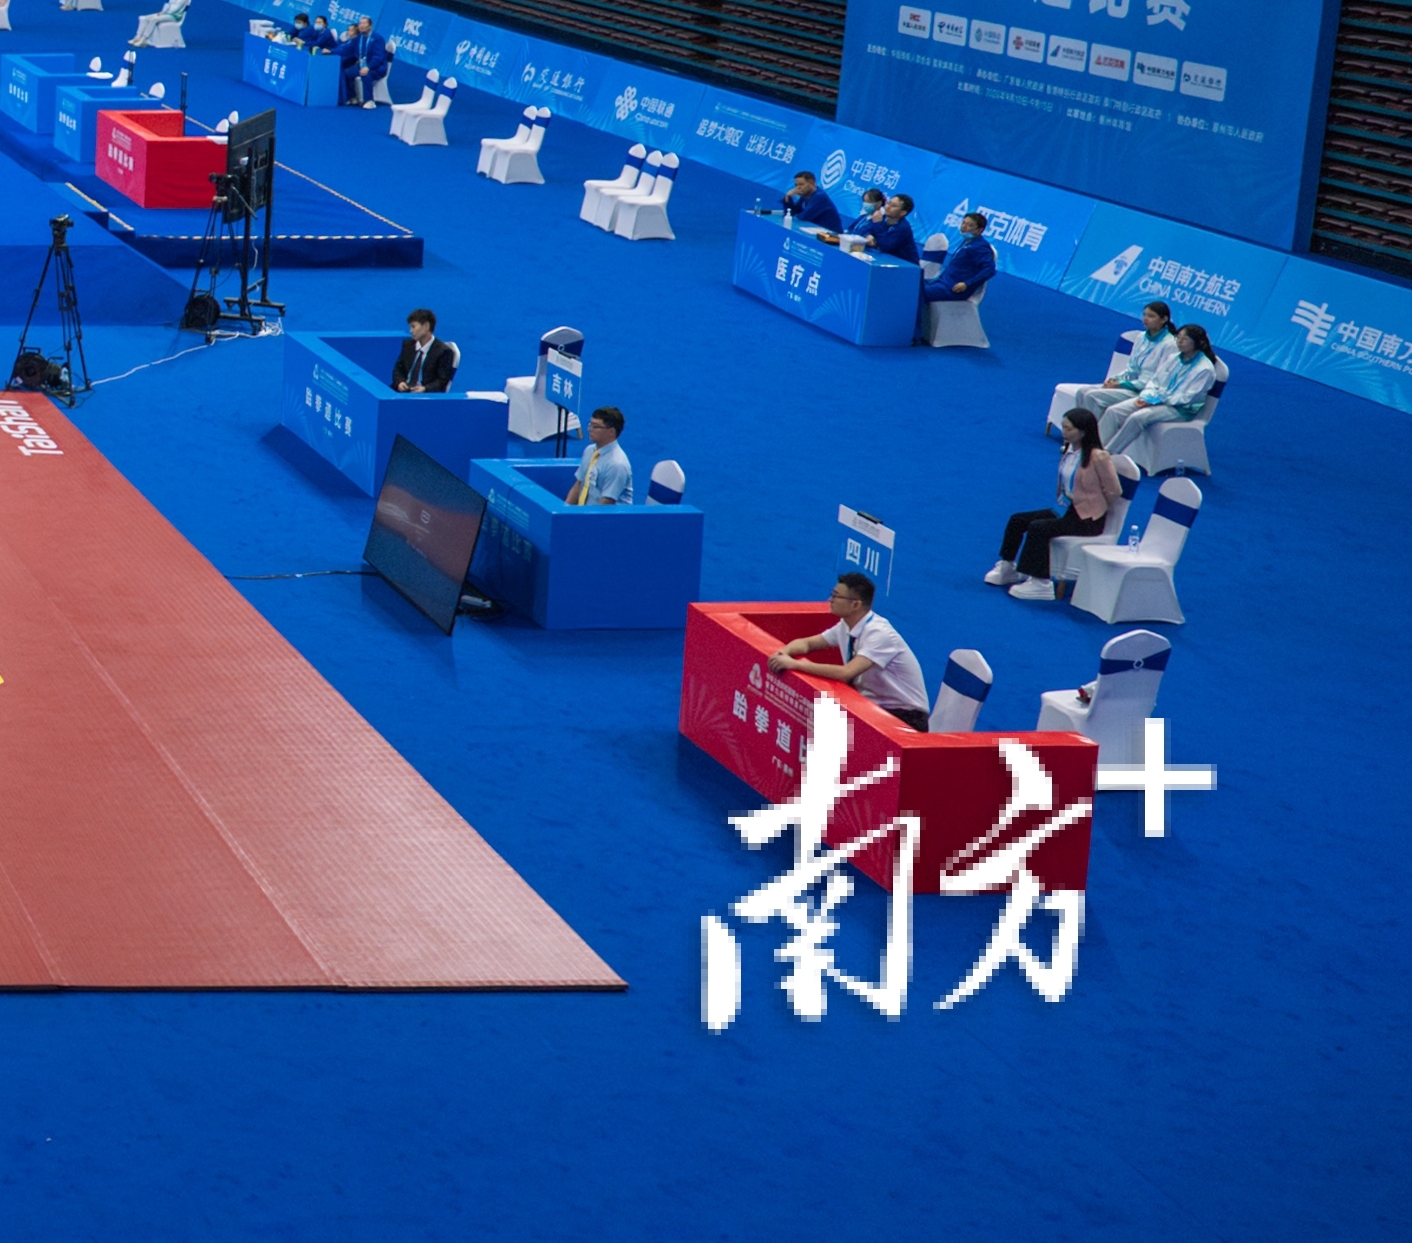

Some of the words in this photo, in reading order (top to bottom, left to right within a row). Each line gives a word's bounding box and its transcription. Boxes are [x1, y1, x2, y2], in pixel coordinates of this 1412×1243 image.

[640, 96, 675, 118] 中国联通
[696, 118, 744, 148] 追梦大湾区
[745, 133, 796, 164] 出彩人生路
[850, 158, 901, 190] 中国移动
[775, 256, 821, 296] 医疗点
[1147, 256, 1241, 302] 中国南方航空
[1139, 278, 1170, 300] CHINA
[1171, 288, 1231, 318] SOUTHERN
[845, 537, 880, 576] 四川
